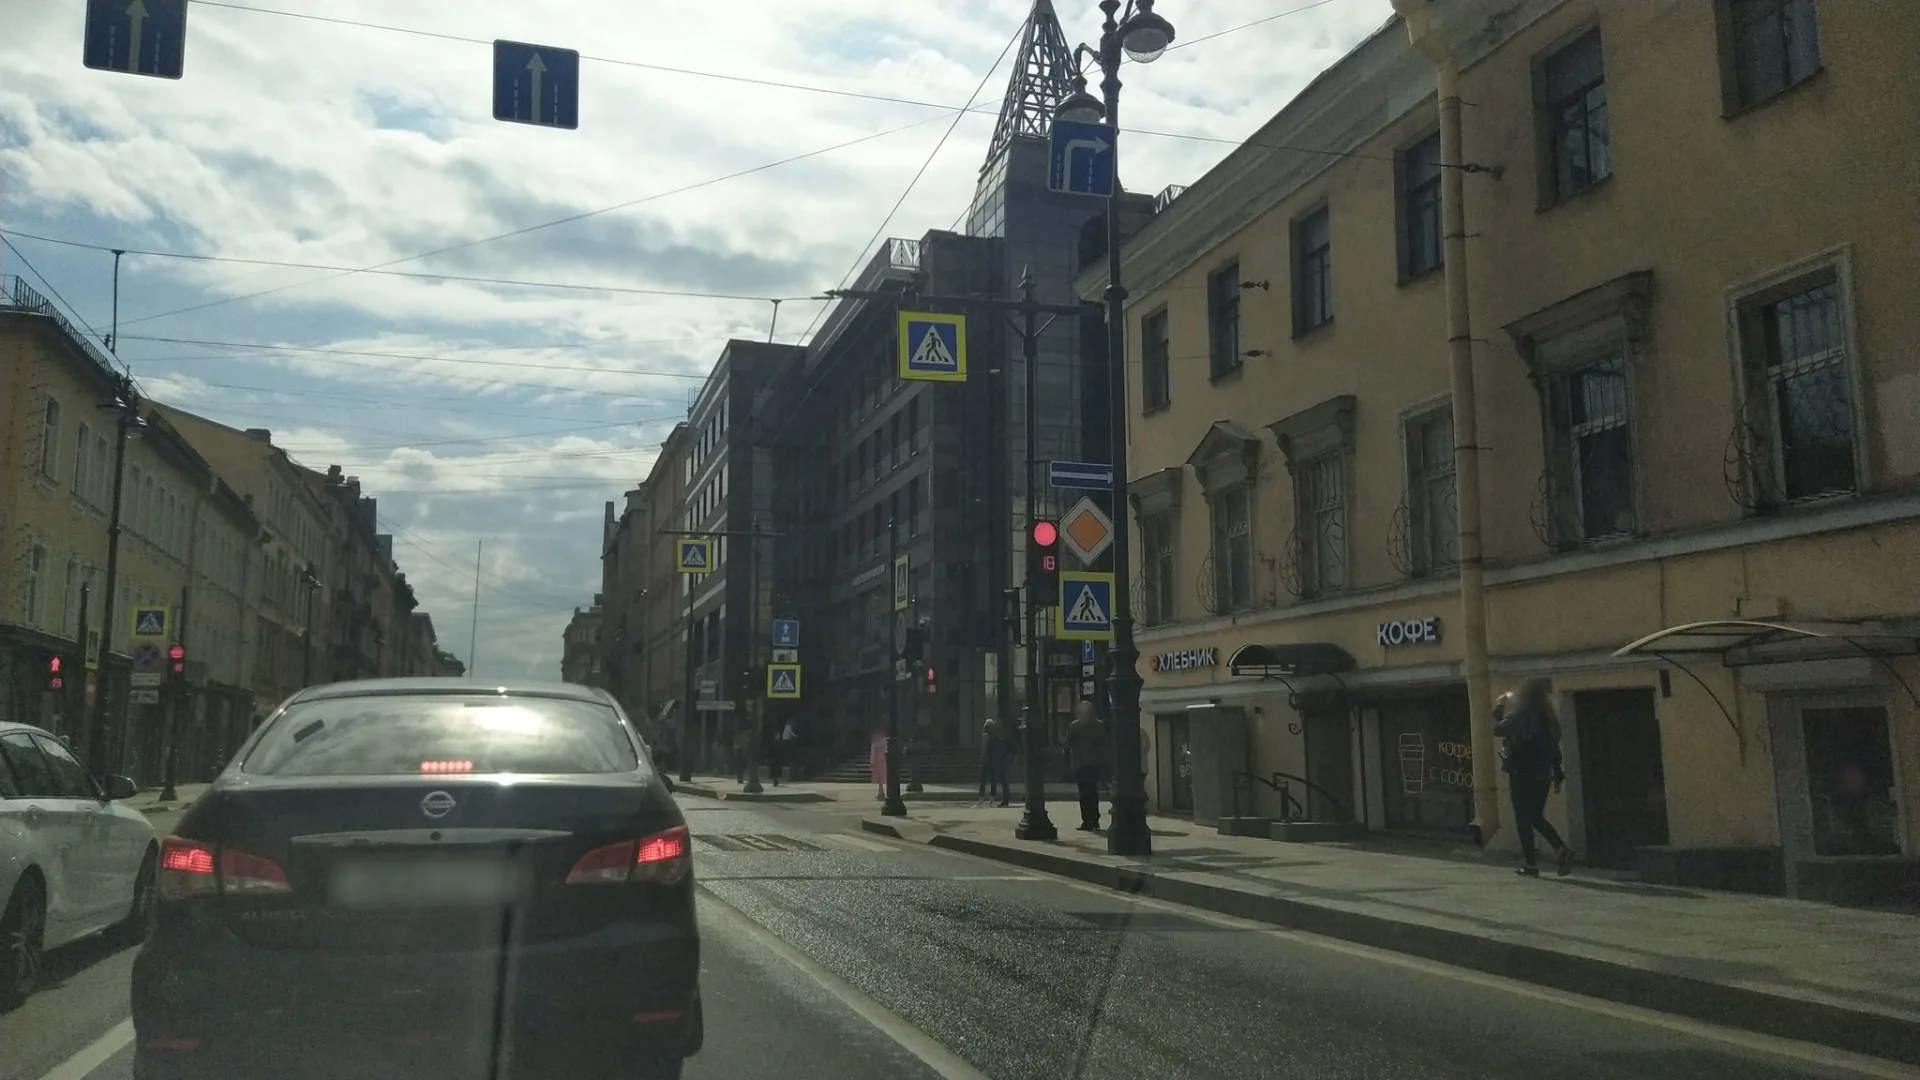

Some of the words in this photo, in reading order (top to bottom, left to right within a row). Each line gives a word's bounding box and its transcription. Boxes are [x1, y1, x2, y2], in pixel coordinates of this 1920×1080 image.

[1377, 617, 1436, 645] КОФЕ
[1158, 647, 1215, 671] ХЛЕБНИК
[1441, 768, 1474, 787] собо
